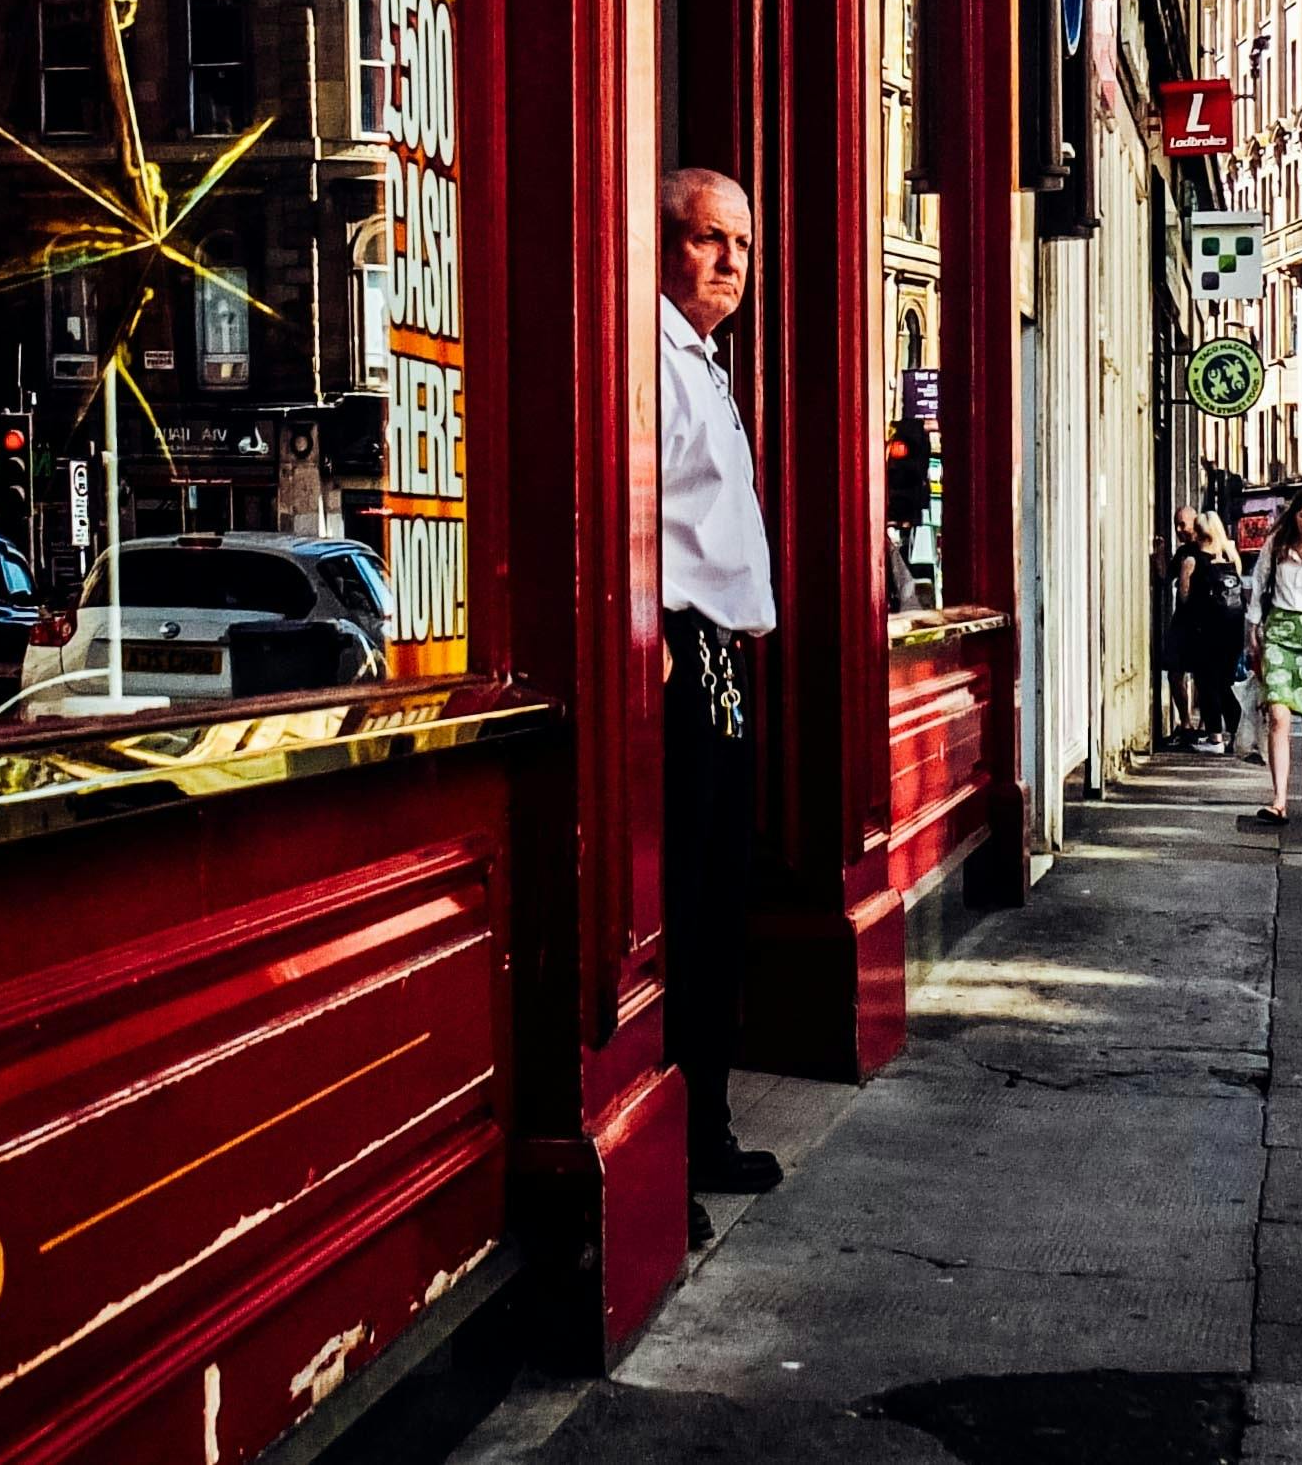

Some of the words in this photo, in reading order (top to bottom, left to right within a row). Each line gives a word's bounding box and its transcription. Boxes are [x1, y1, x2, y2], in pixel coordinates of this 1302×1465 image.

[1185, 92, 1211, 133] L
[386, 151, 460, 339] CASH
[388, 352, 463, 499] HERE
[389, 517, 465, 644] NOW!
